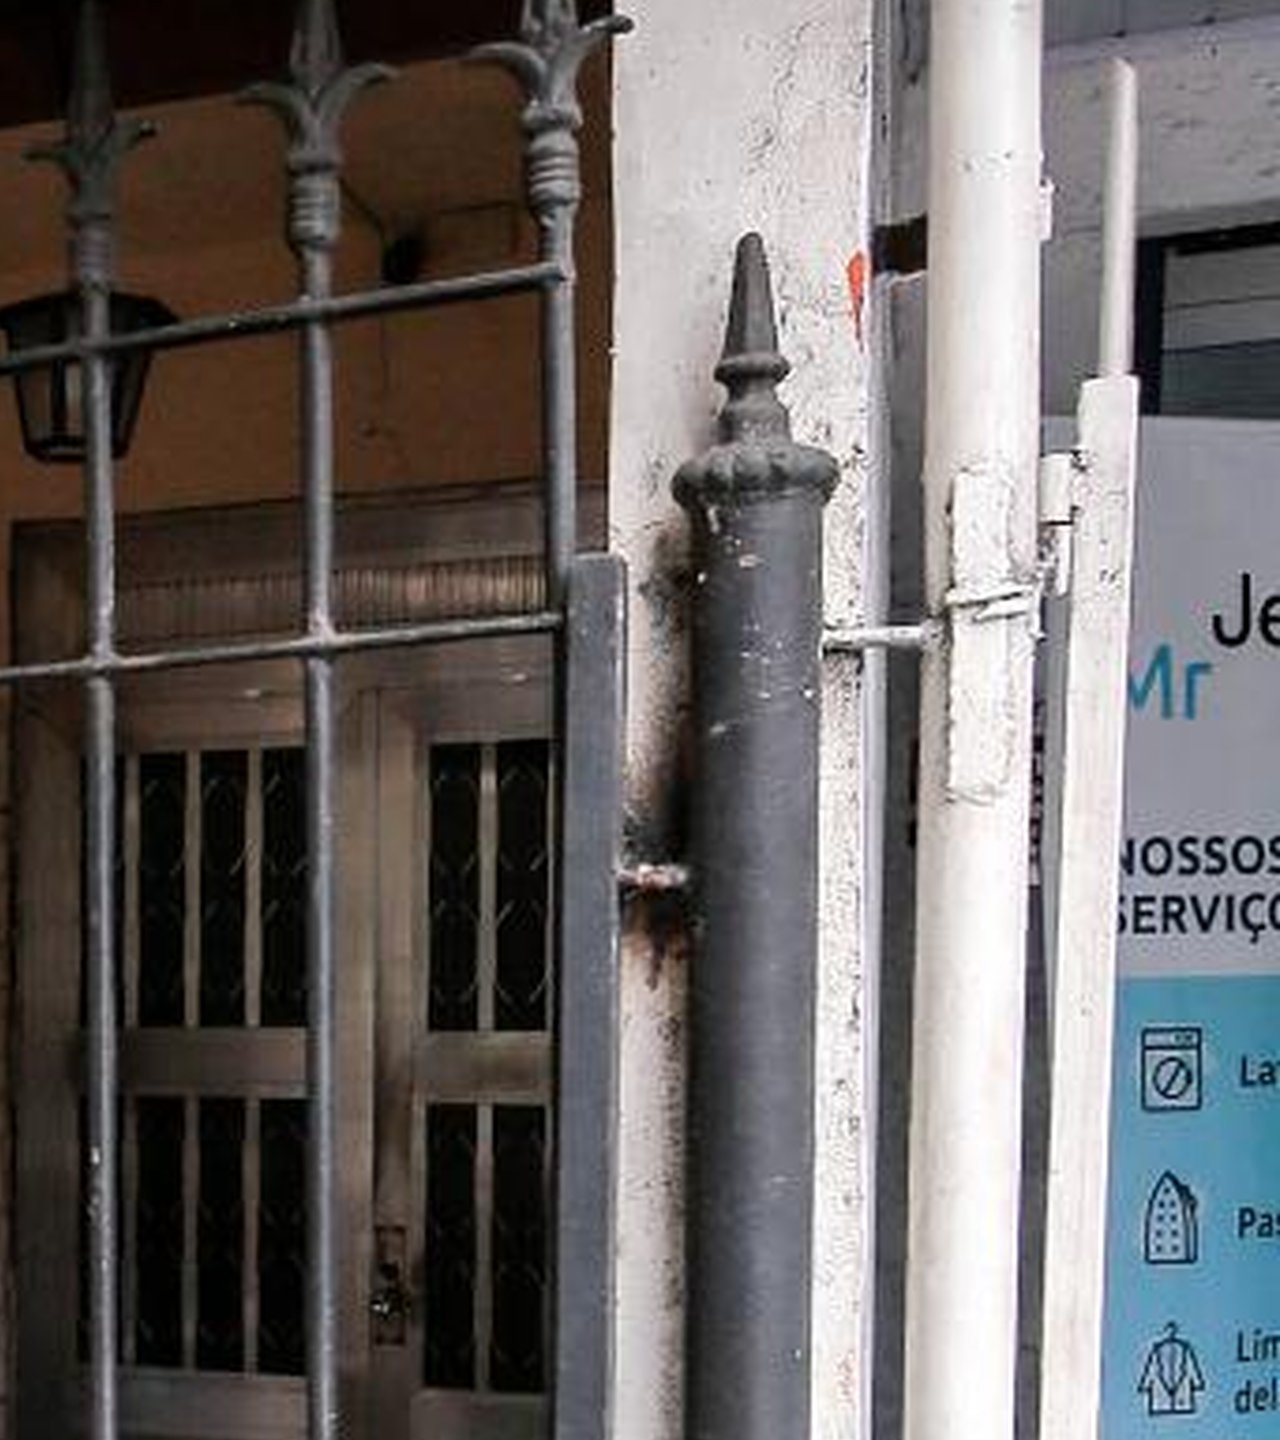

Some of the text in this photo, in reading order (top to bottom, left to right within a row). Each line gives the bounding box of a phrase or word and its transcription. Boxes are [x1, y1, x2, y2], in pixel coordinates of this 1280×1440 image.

[1128, 643, 1212, 720] Mr
[1240, 1054, 1280, 1087] La
[1238, 1206, 1280, 1240] Pa
